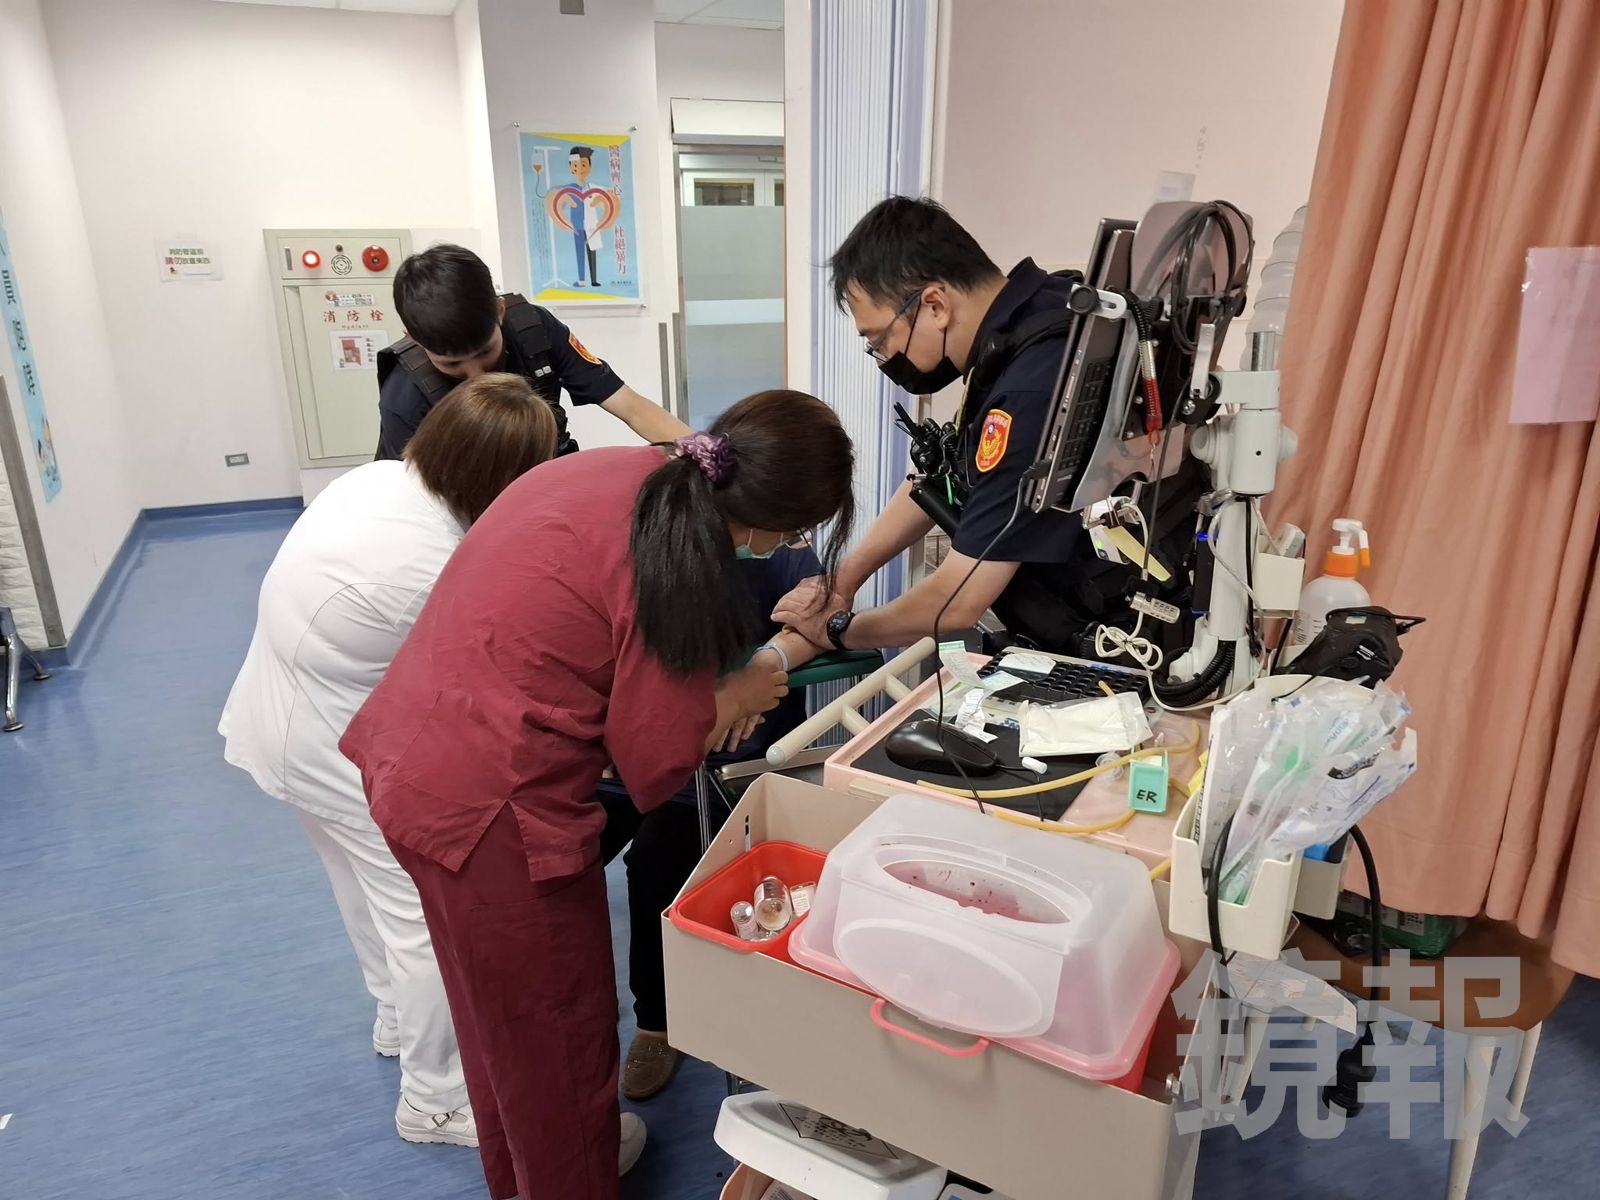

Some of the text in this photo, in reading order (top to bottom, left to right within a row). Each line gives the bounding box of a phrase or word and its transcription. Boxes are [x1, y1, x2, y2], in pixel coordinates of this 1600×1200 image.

[614, 225, 626, 274] 杜絕暴力
[323, 309, 384, 323] 消防栓
[1136, 789, 1158, 803] ER
